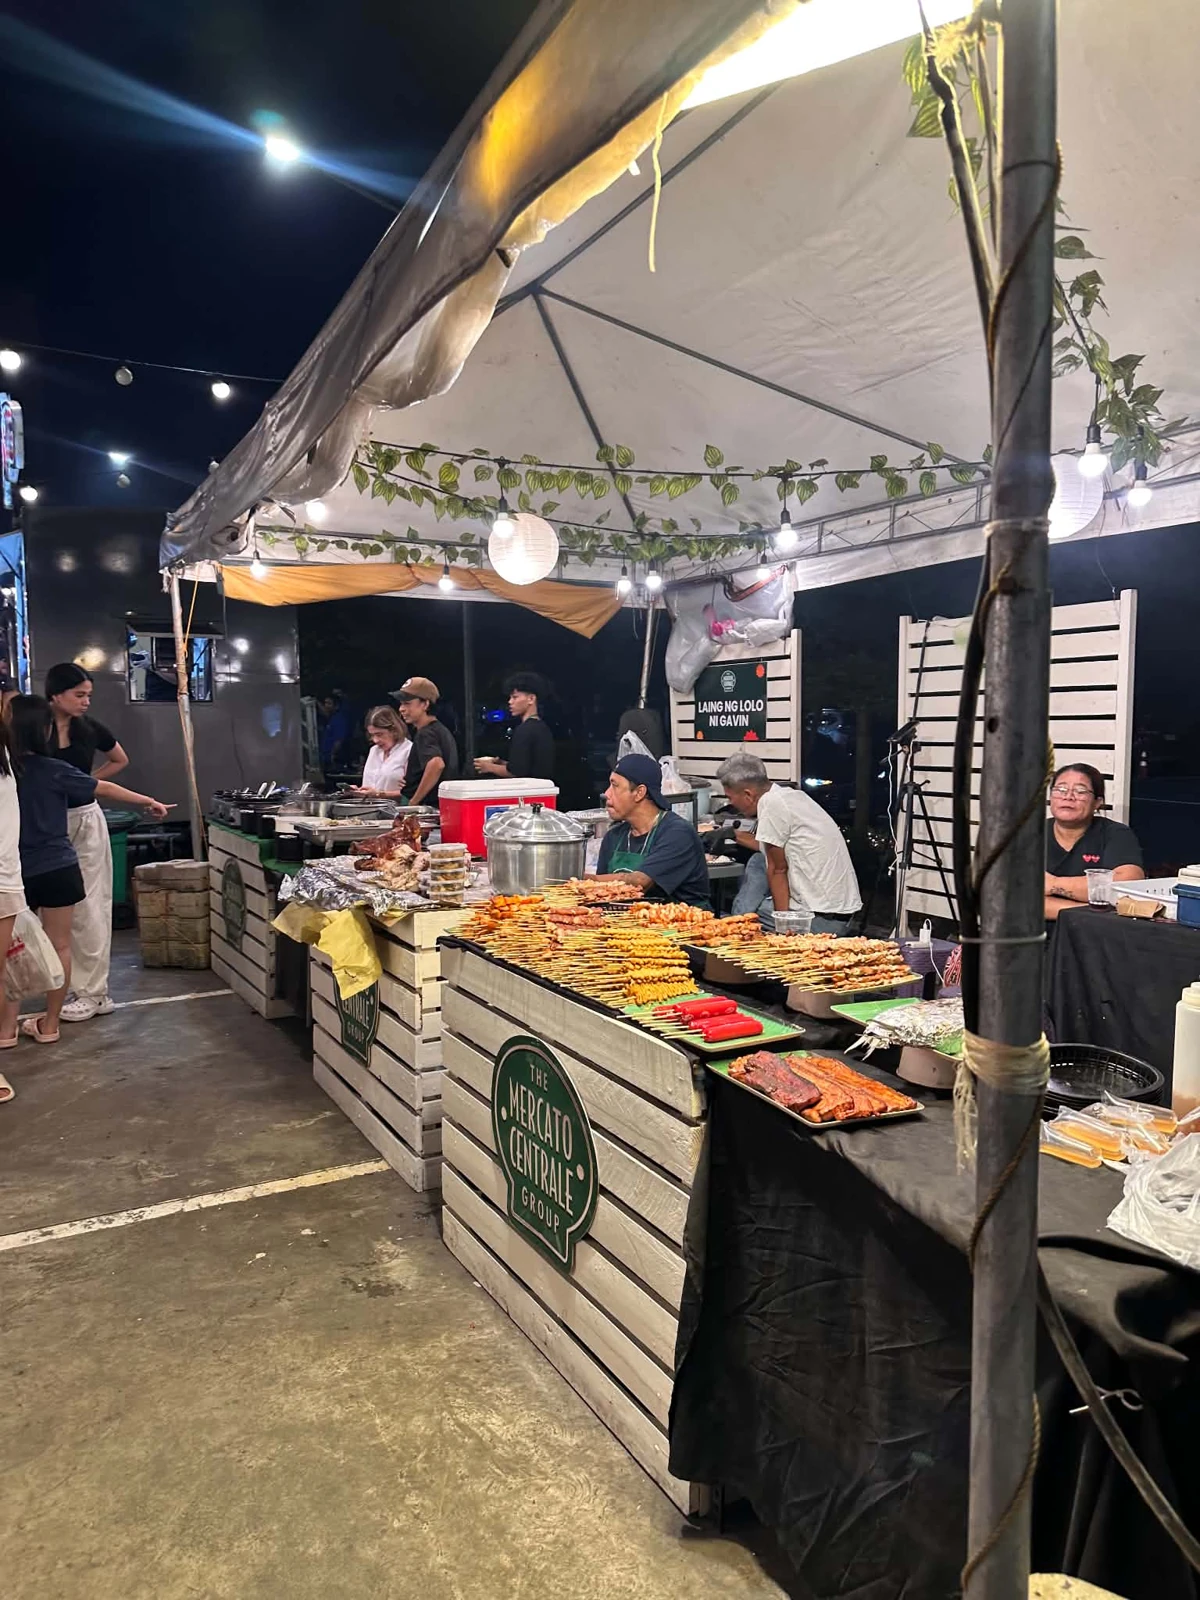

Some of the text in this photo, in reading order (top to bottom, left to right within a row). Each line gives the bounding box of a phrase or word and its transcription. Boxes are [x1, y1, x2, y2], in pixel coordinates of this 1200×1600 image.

[698, 699, 764, 713] LAING NG LOLO
[709, 714, 749, 727] NI GAVIN
[530, 1064, 548, 1092] THE
[509, 1077, 573, 1161] MERCATO
[509, 1126, 574, 1216] CENTRALE
[521, 1185, 560, 1233] GROUP
